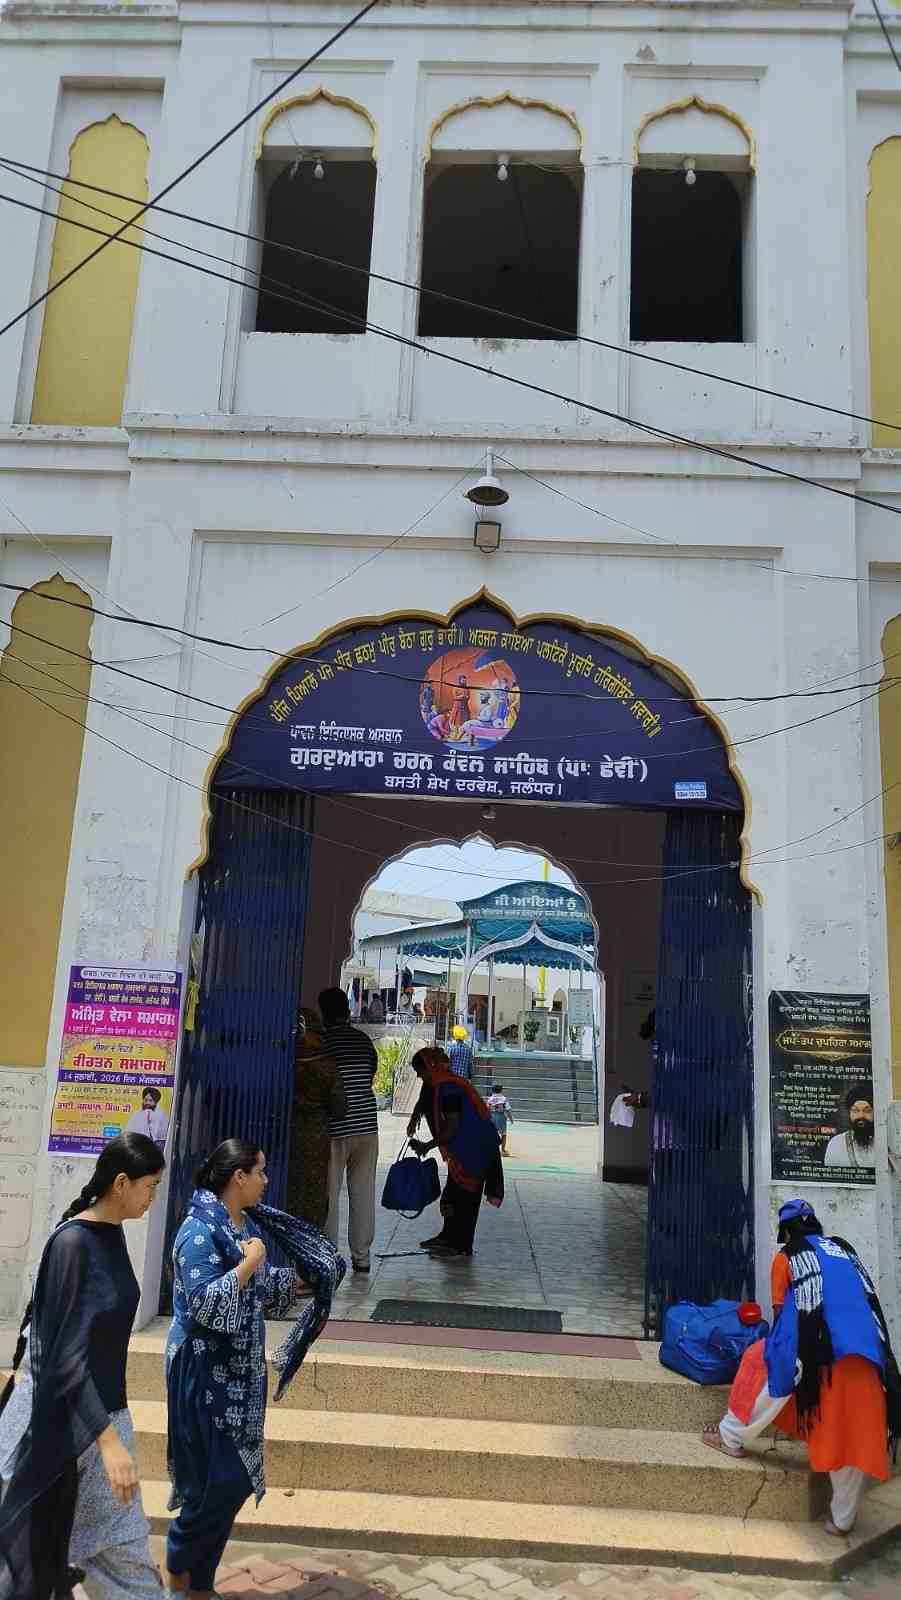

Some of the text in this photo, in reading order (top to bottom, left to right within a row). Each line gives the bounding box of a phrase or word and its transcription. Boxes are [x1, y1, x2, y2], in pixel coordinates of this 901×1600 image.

[290, 720, 404, 744] ਪਾਵਨ ਇਤਿਹਾਸਕ ਅਸਥਾਨ
[290, 747, 384, 771] ਗੁਰਦੁਆਰਾ
[393, 752, 434, 771] ਚਰਨ
[443, 749, 485, 773] ਕੰਵਲ
[494, 753, 549, 776] ਸਾਹਿਬ
[384, 772, 422, 789] ਬਸਤੀ
[427, 773, 450, 791] ਸ਼ੇਖ
[495, 894, 509, 906] ਜੀ
[71, 1005, 104, 1025] ਅੰਮ੍ਰਿਤ
[109, 1006, 132, 1023] ਵੇਲਾ
[73, 1053, 167, 1071] ਕੀਰਤਨ ਸਮਾਗਮ
